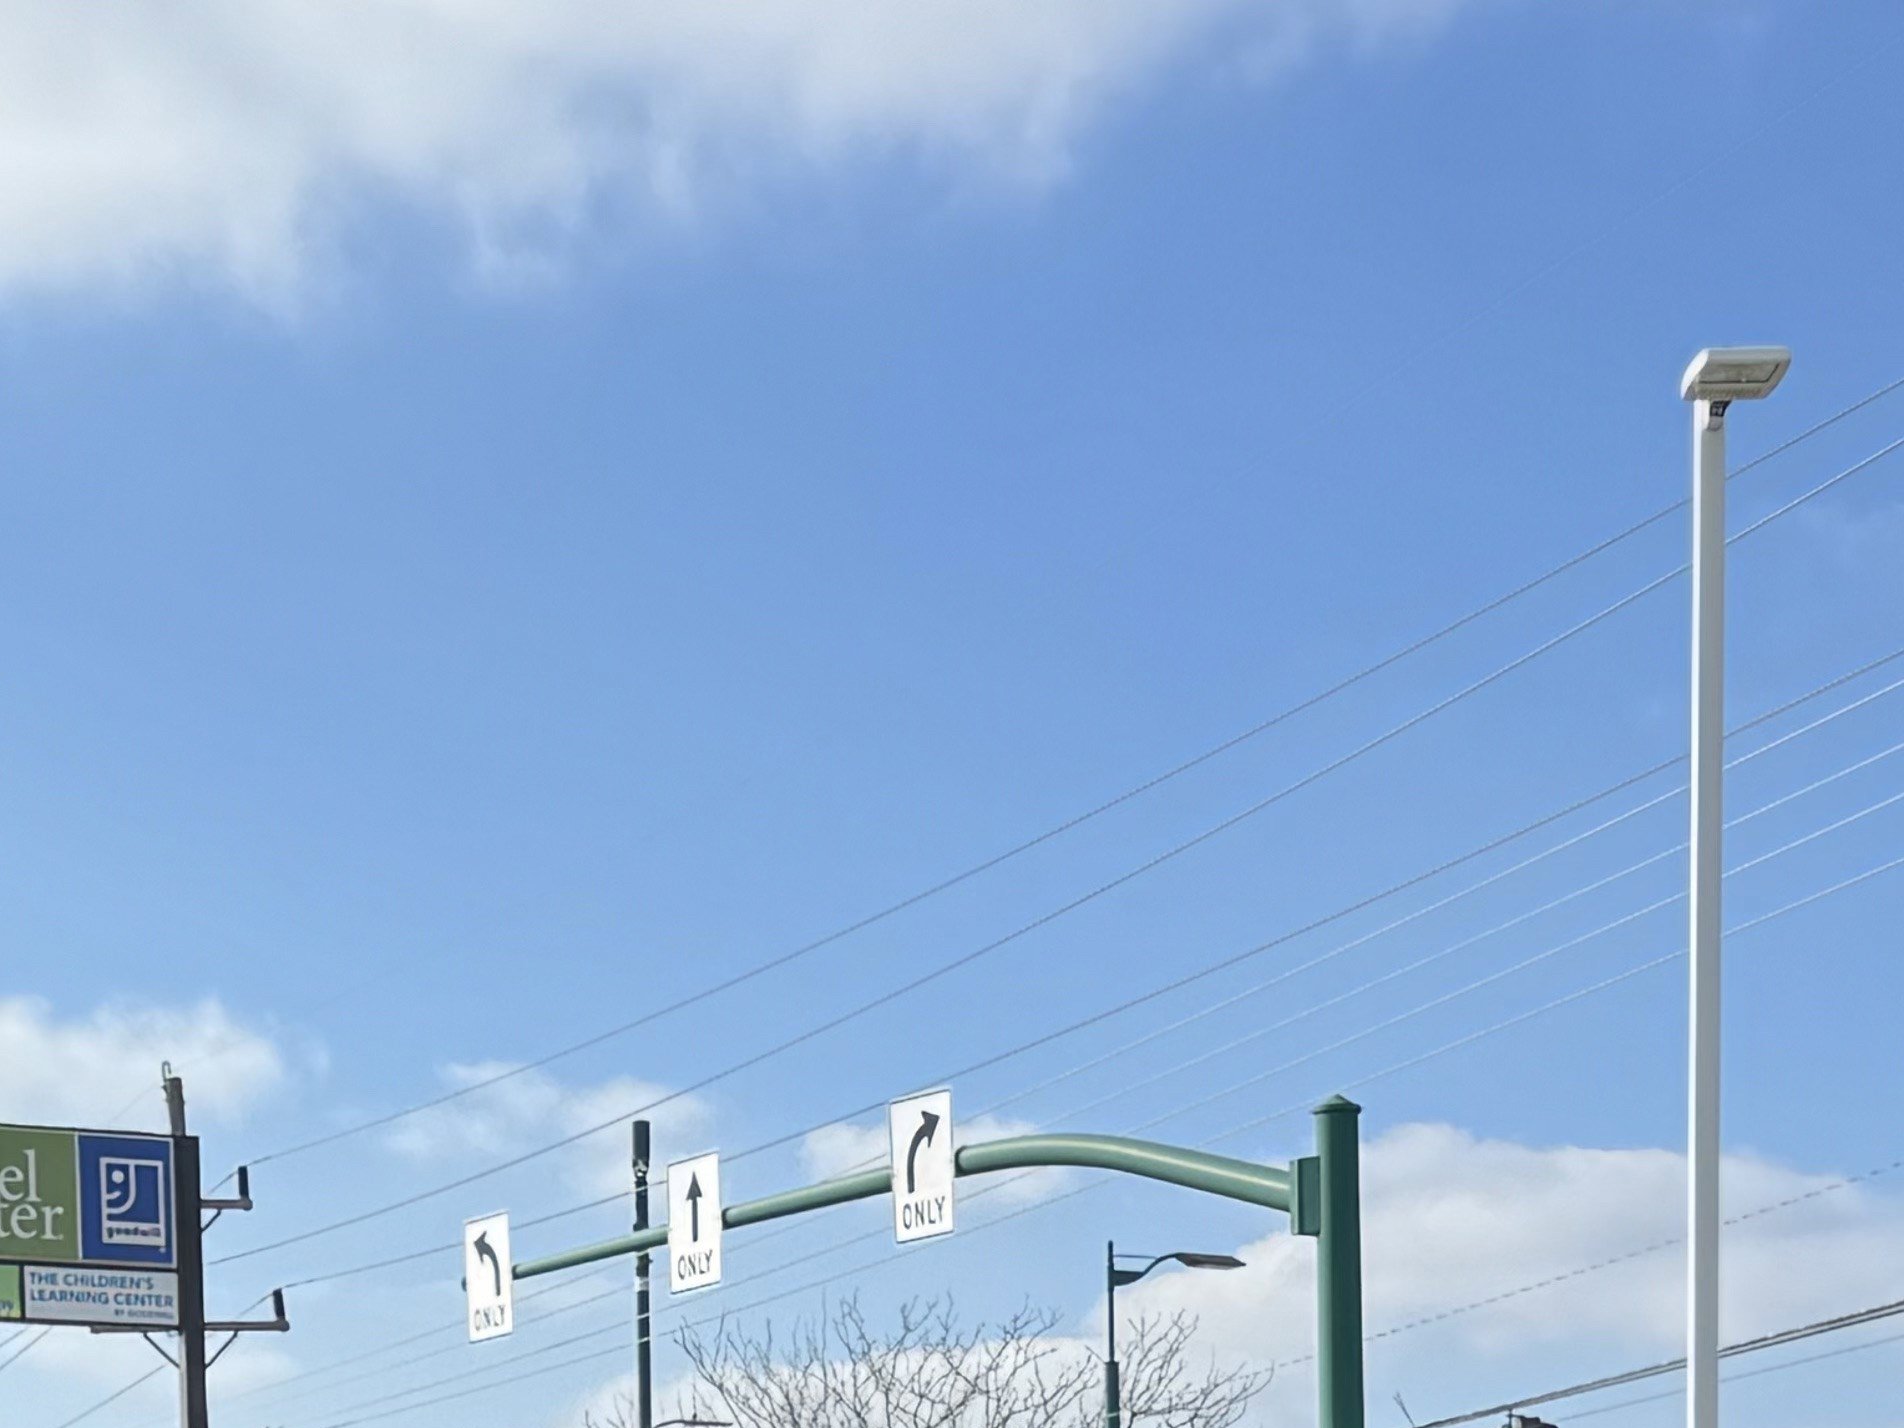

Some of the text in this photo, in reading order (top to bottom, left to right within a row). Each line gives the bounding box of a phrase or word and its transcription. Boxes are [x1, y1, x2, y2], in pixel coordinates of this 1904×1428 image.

[902, 1196, 946, 1230] ONLY
[677, 1249, 714, 1280] ONLY
[29, 1271, 154, 1290] THE CHILDREN'S
[30, 1291, 174, 1308] LEARNING CENTER
[473, 1302, 507, 1331] ONLY
